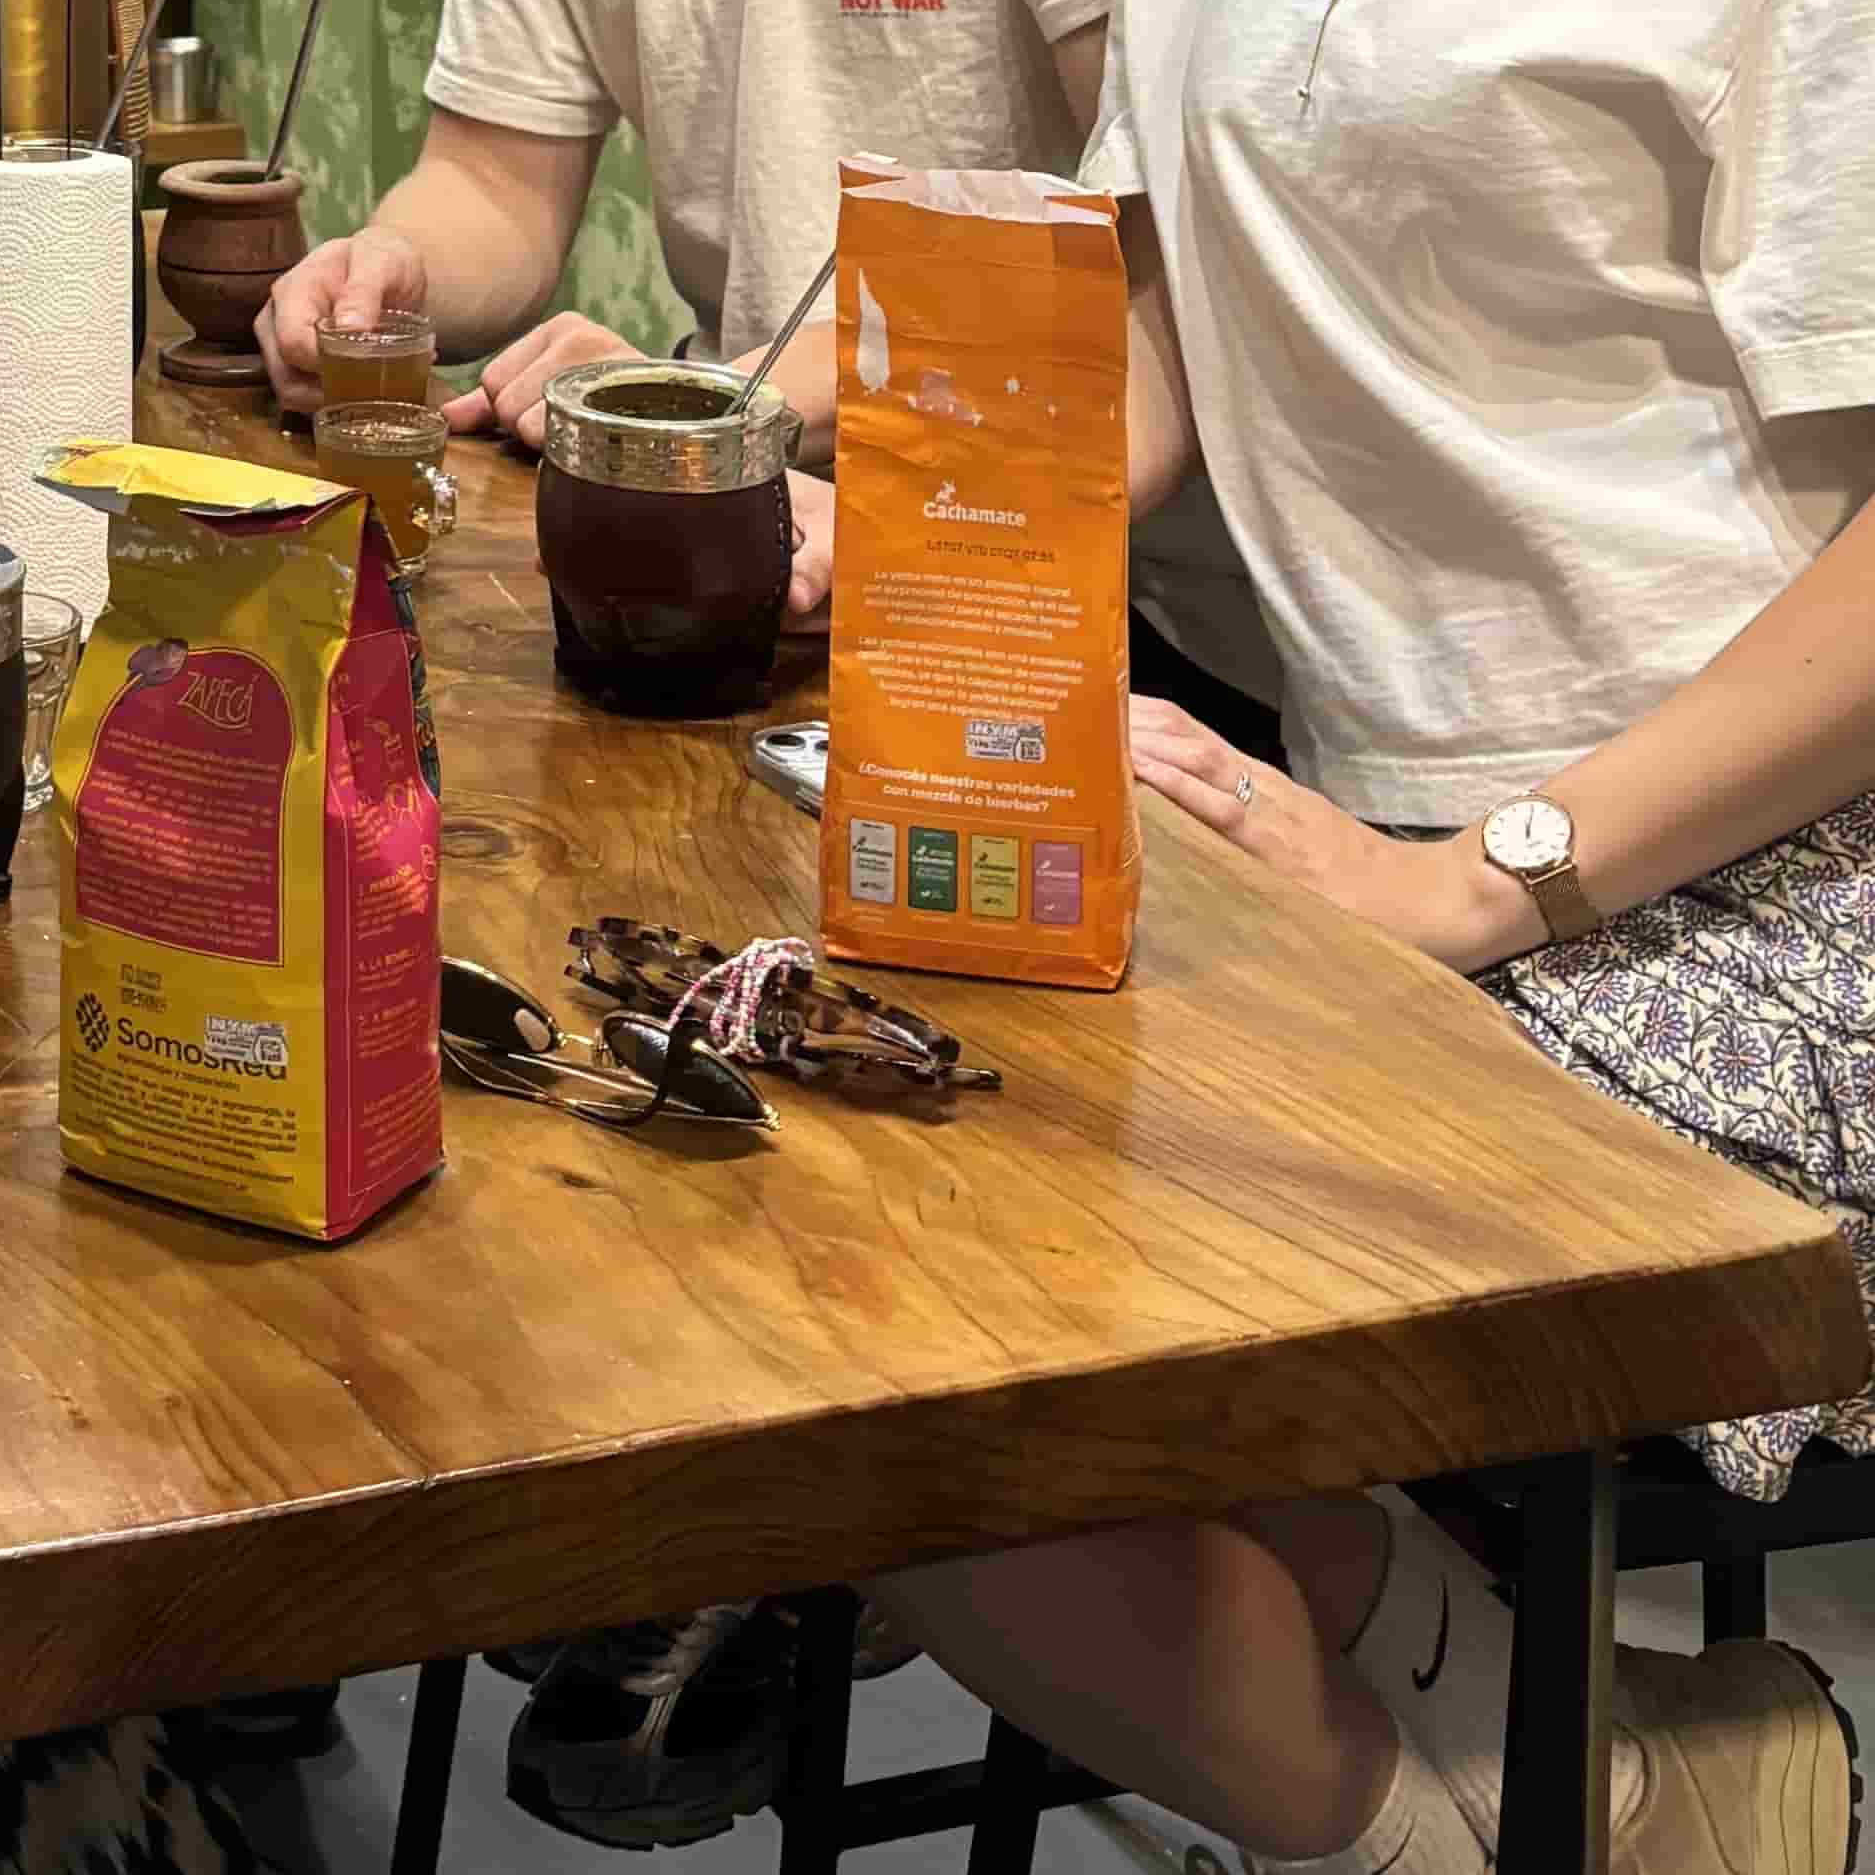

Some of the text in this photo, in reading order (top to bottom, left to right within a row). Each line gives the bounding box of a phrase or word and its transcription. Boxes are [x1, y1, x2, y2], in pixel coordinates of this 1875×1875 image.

[923, 500, 1027, 527] Cachamate
[883, 783, 909, 797] con
[911, 787, 961, 804] mezcla
[964, 794, 984, 807] de
[930, 772, 993, 791] nuestras
[996, 778, 1076, 798] variedades
